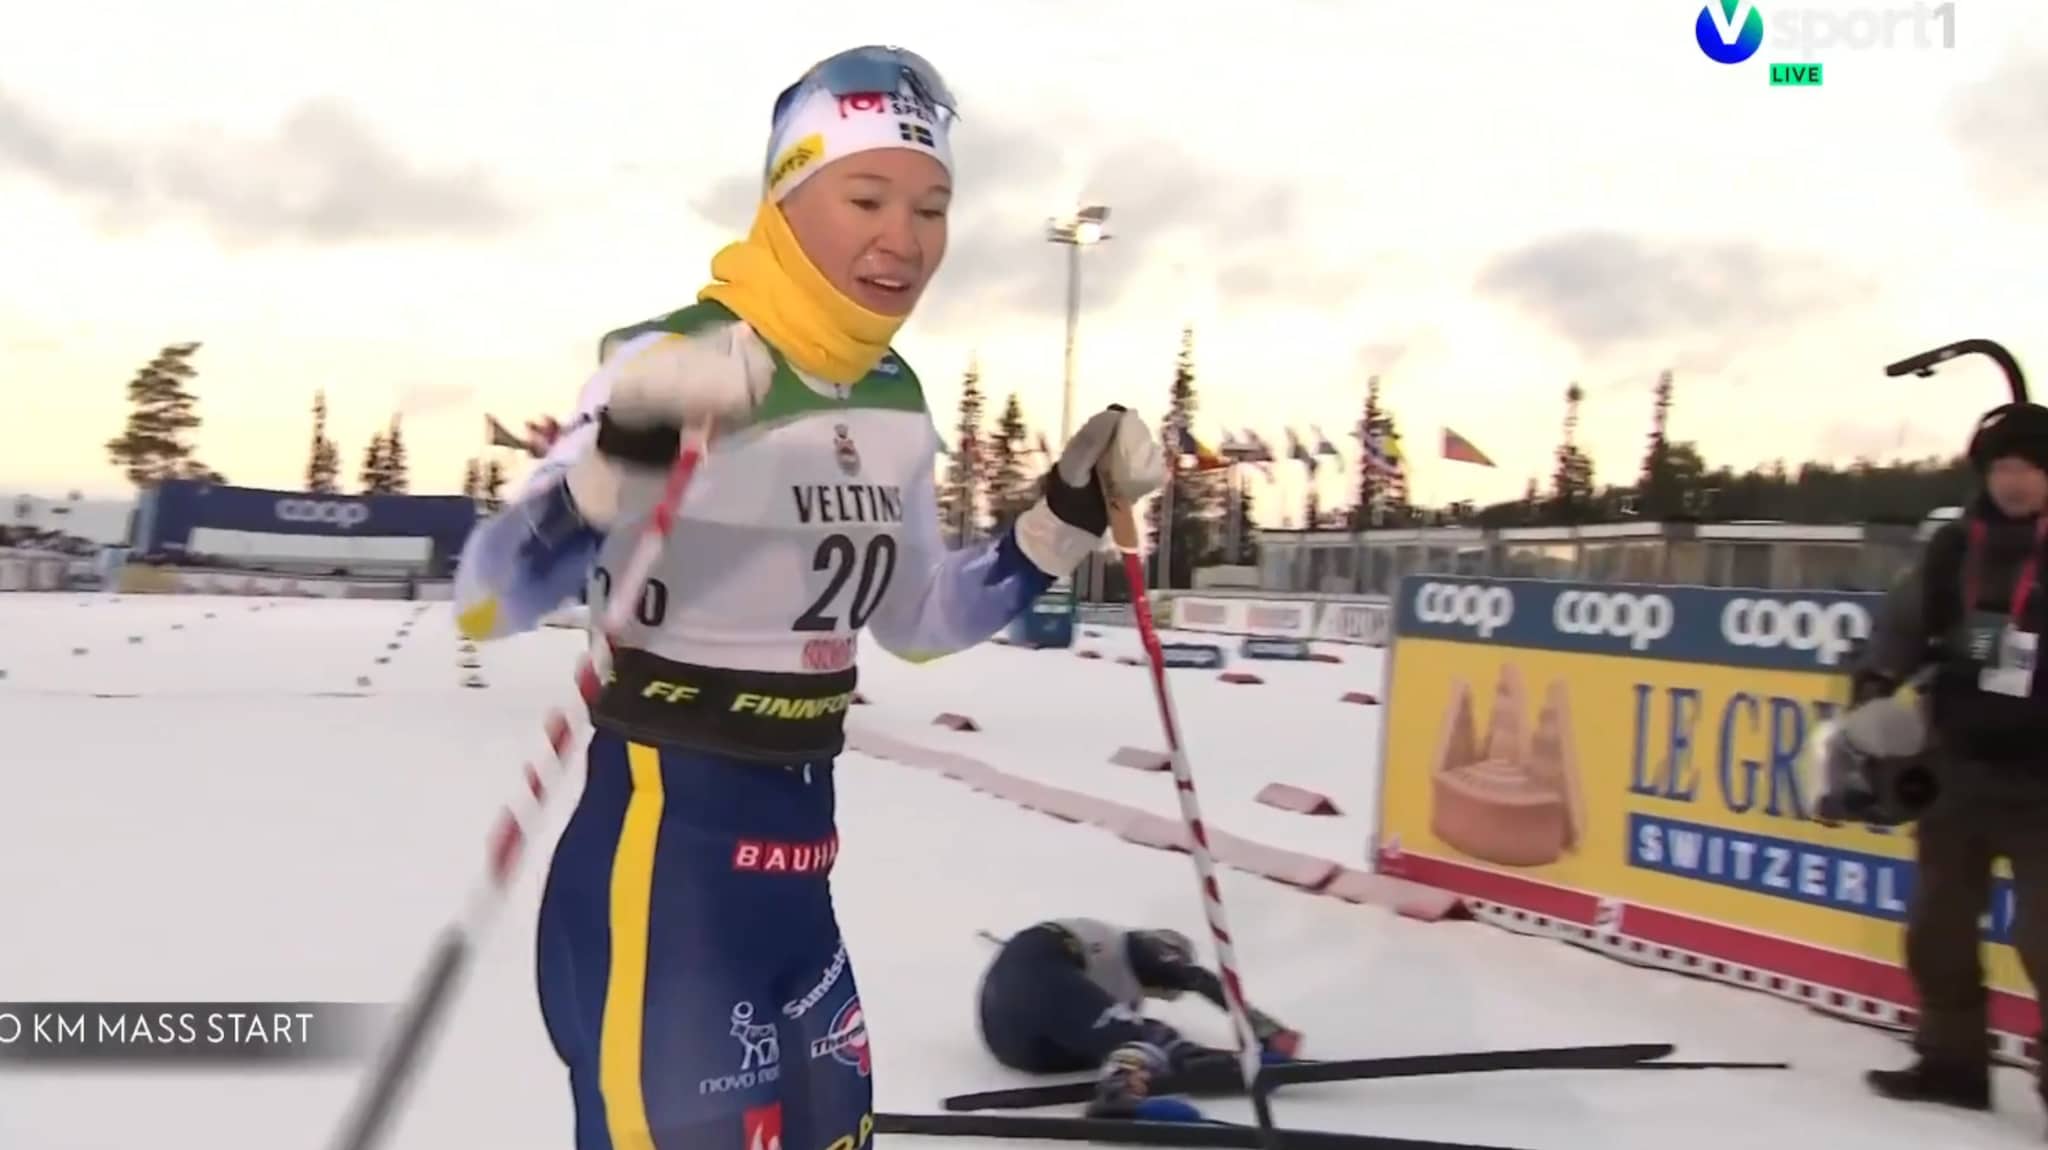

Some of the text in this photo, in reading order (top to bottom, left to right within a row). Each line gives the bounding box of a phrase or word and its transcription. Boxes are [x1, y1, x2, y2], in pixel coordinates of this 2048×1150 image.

[275, 499, 369, 529] coop
[792, 533, 897, 632] 20
[1415, 582, 1514, 638] coop
[1553, 590, 1674, 651] coop
[1721, 598, 1870, 665] coop
[641, 681, 700, 703] FF
[1628, 683, 1699, 803] LE
[700, 1072, 756, 1095] novo
